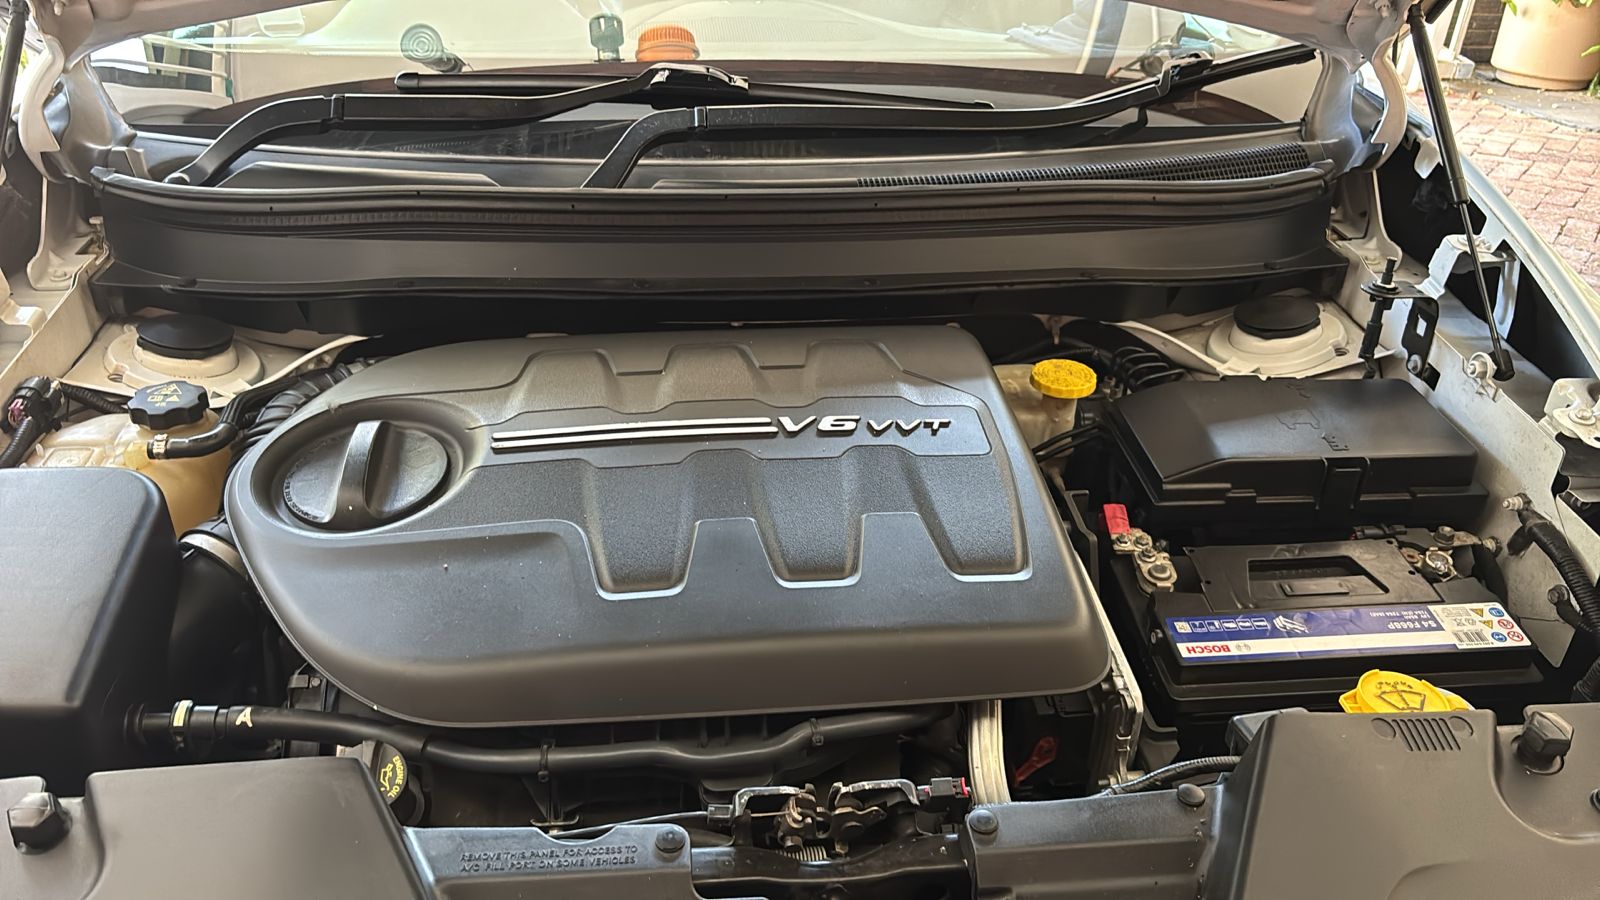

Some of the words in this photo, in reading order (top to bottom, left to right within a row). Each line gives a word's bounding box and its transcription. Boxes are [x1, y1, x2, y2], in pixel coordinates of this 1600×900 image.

[778, 415, 861, 436] V6
[867, 419, 951, 437] VVT
[1186, 644, 1231, 654] BOSCH
[235, 706, 253, 728] A
[392, 755, 404, 785] ENGINE
[387, 785, 400, 798] OIL
[461, 851, 502, 862] REMOVE
[503, 851, 526, 860] THIS
[530, 849, 560, 860] PANEL
[563, 848, 583, 857] FOR
[585, 846, 622, 856] ACCESS
[624, 845, 638, 854] TO
[461, 863, 480, 872] A/C
[485, 862, 505, 872] FILL
[509, 860, 536, 870] PORT
[539, 860, 554, 869] ON
[556, 859, 585, 868] SOME
[590, 856, 636, 866] VEHICLES
